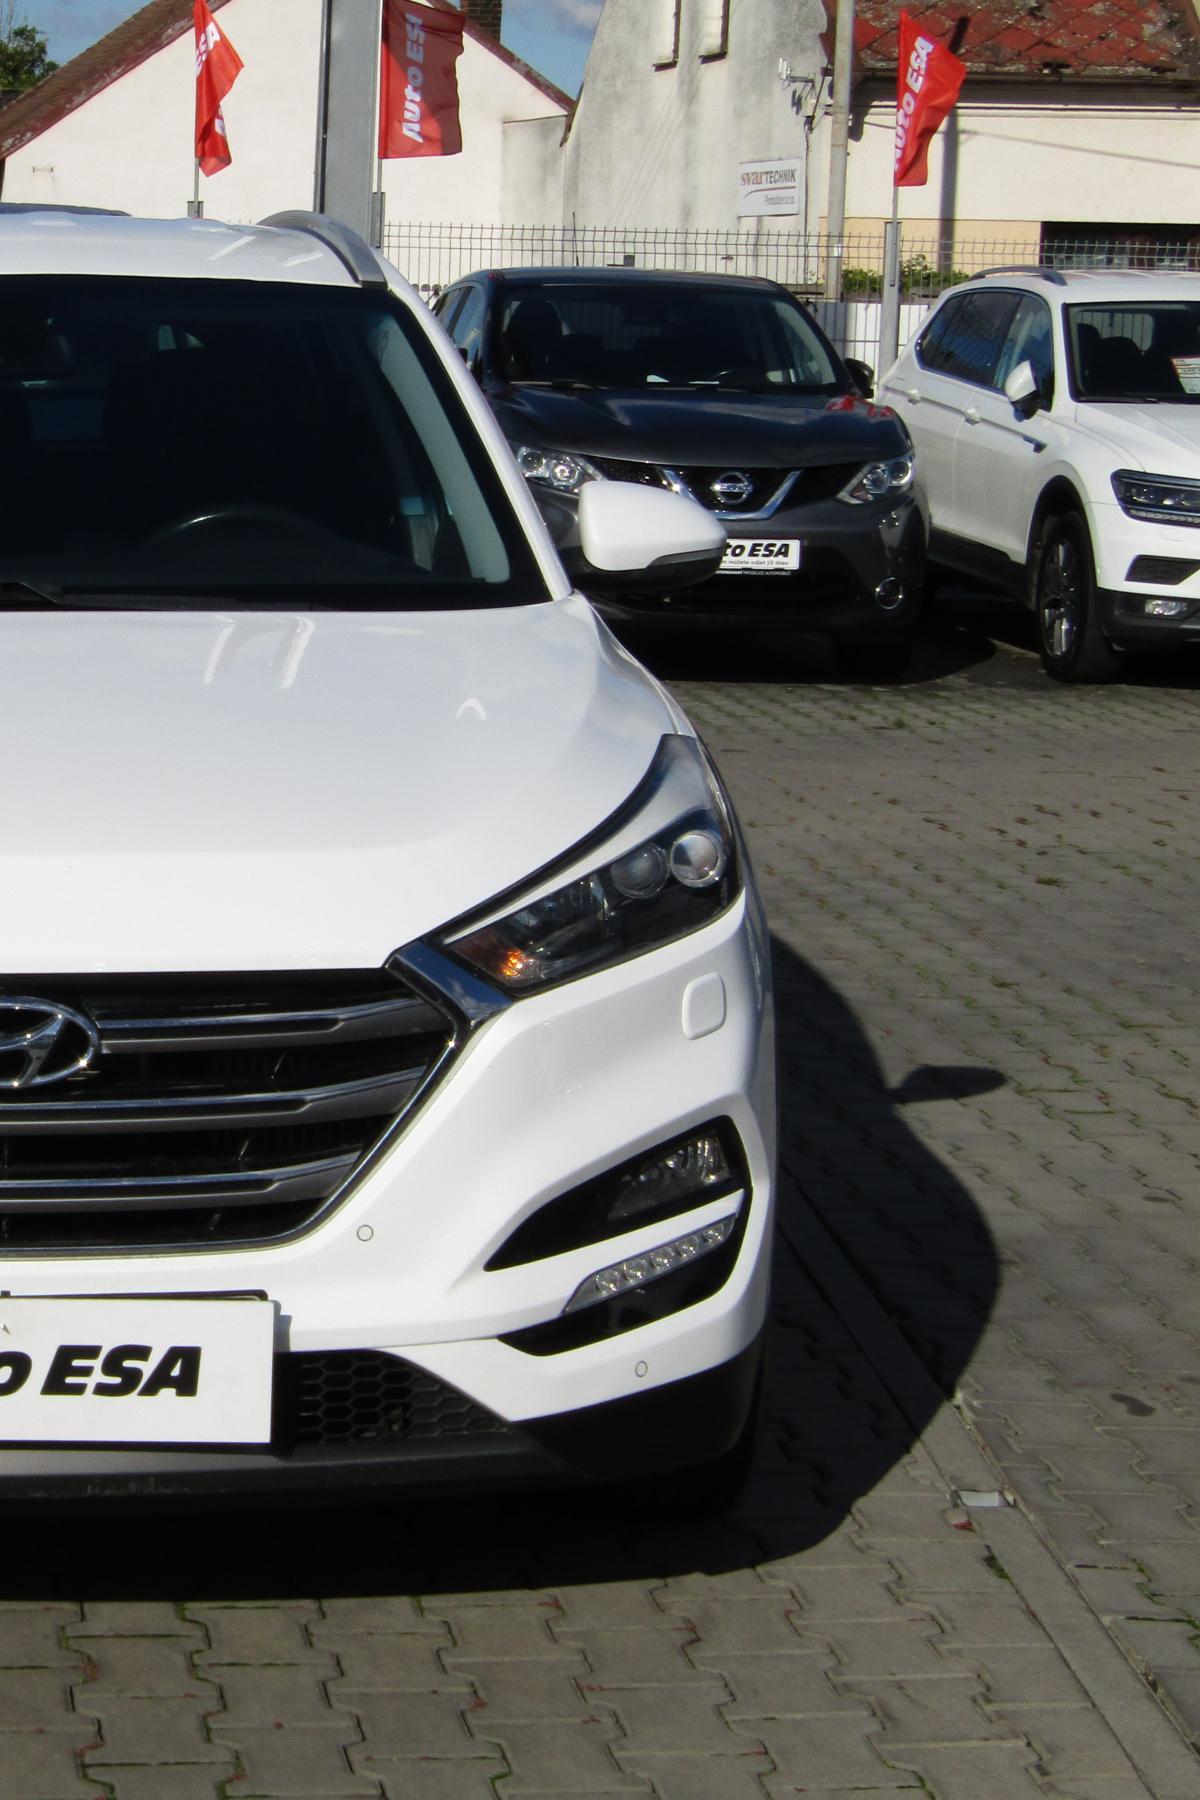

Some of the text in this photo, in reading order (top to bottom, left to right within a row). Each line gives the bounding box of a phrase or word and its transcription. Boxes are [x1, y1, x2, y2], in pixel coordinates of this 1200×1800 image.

[906, 36, 934, 93] ESA
[402, 66, 424, 143] Auto
[722, 542, 789, 558] to ESA
[40, 1344, 202, 1397] ESA
